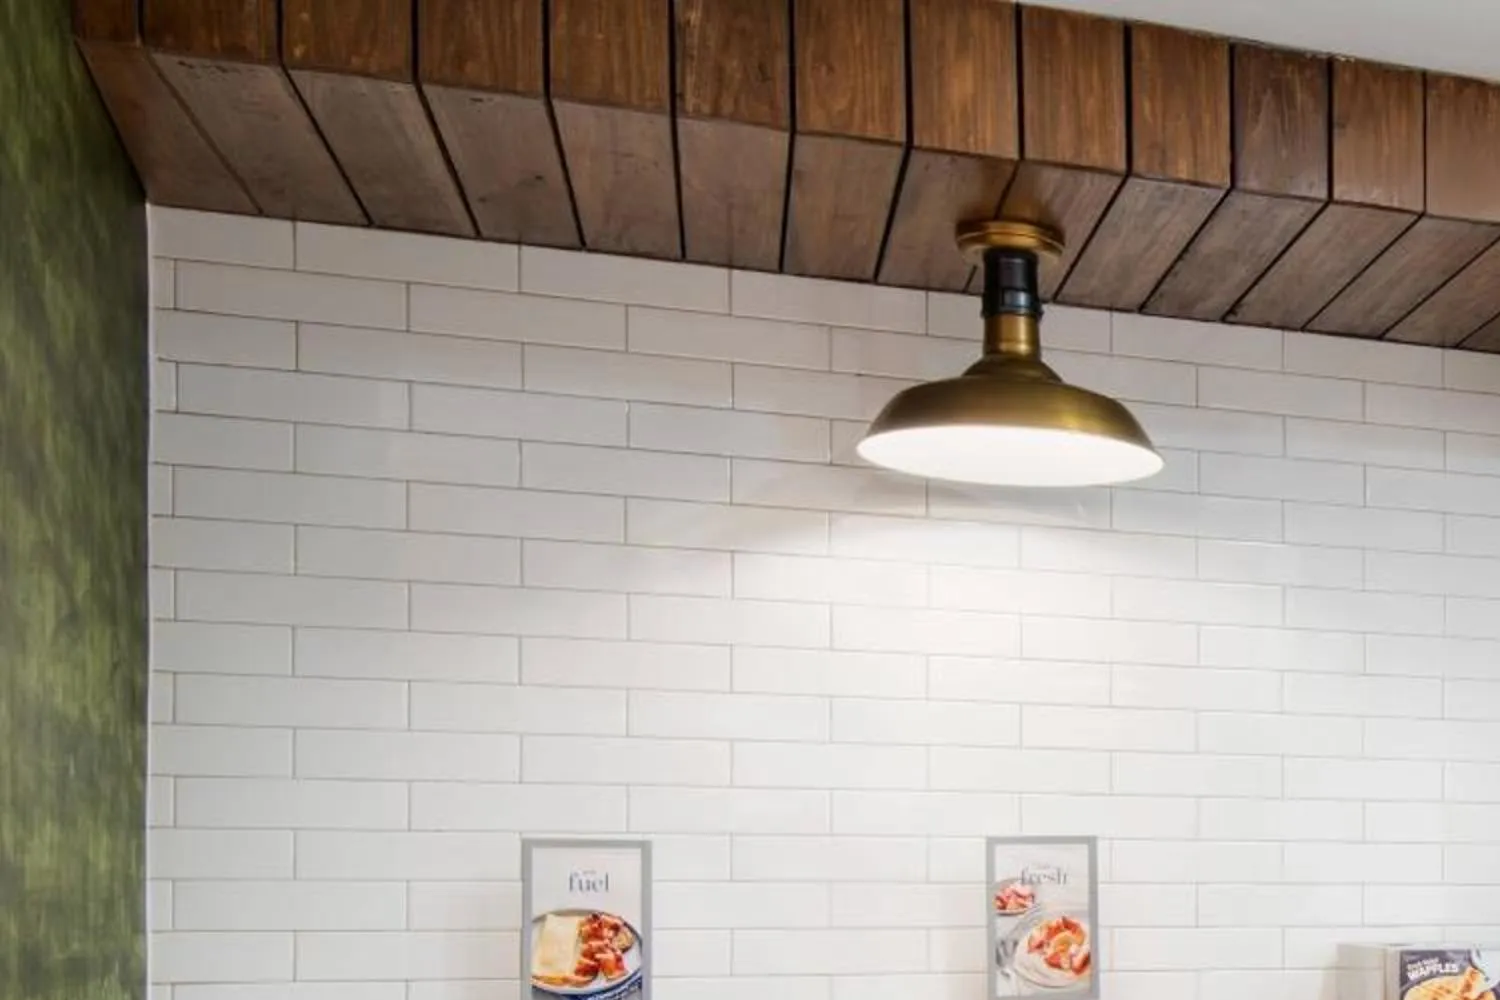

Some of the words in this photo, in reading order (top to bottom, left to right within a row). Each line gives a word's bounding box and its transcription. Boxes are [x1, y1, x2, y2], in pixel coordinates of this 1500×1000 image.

[569, 871, 610, 893] fuel
[1021, 866, 1068, 886] fresh
[1407, 962, 1460, 981] WAFFLES
